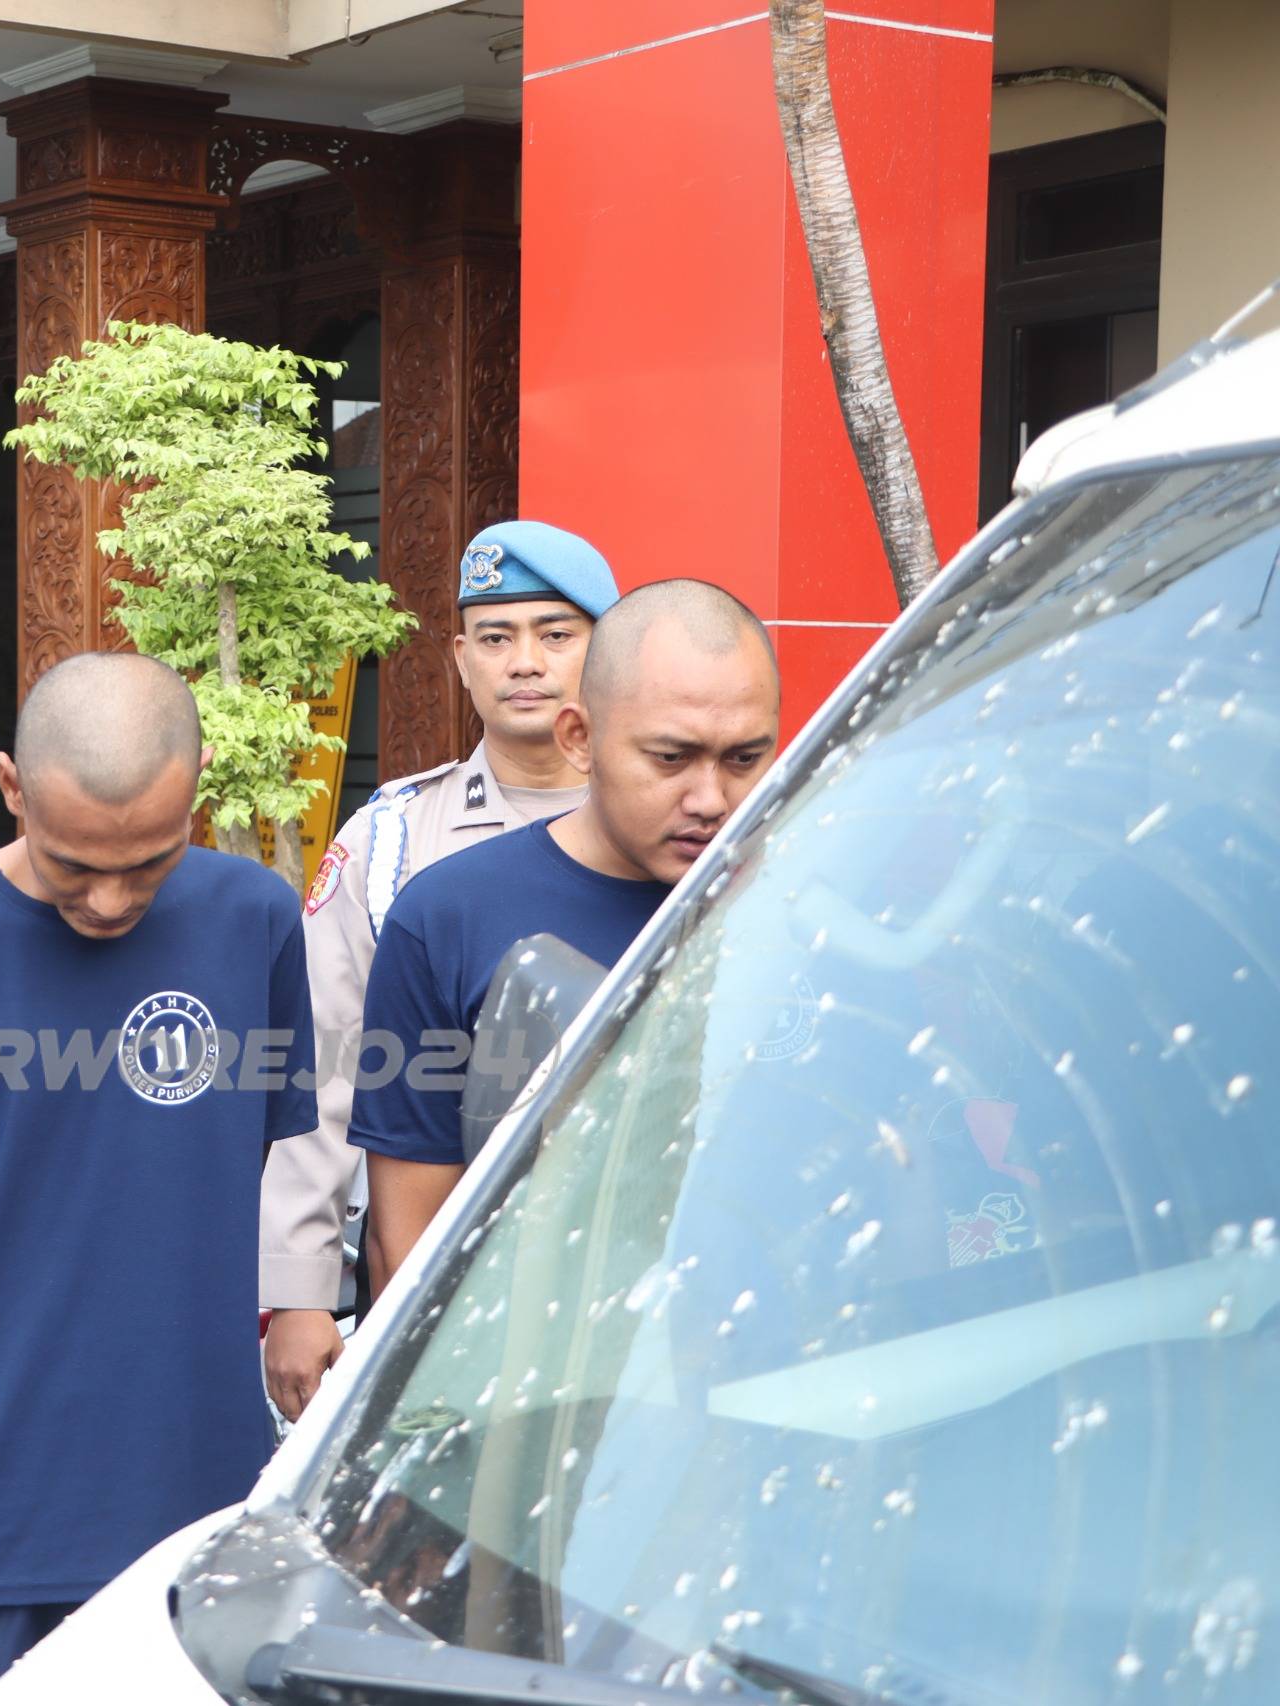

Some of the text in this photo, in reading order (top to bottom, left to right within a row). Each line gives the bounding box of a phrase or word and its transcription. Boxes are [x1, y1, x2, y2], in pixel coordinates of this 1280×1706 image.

[137, 996, 204, 1020] TAHTI
[123, 1043, 217, 1100] POLRES PURWOREJO
[149, 1023, 190, 1073] 11
